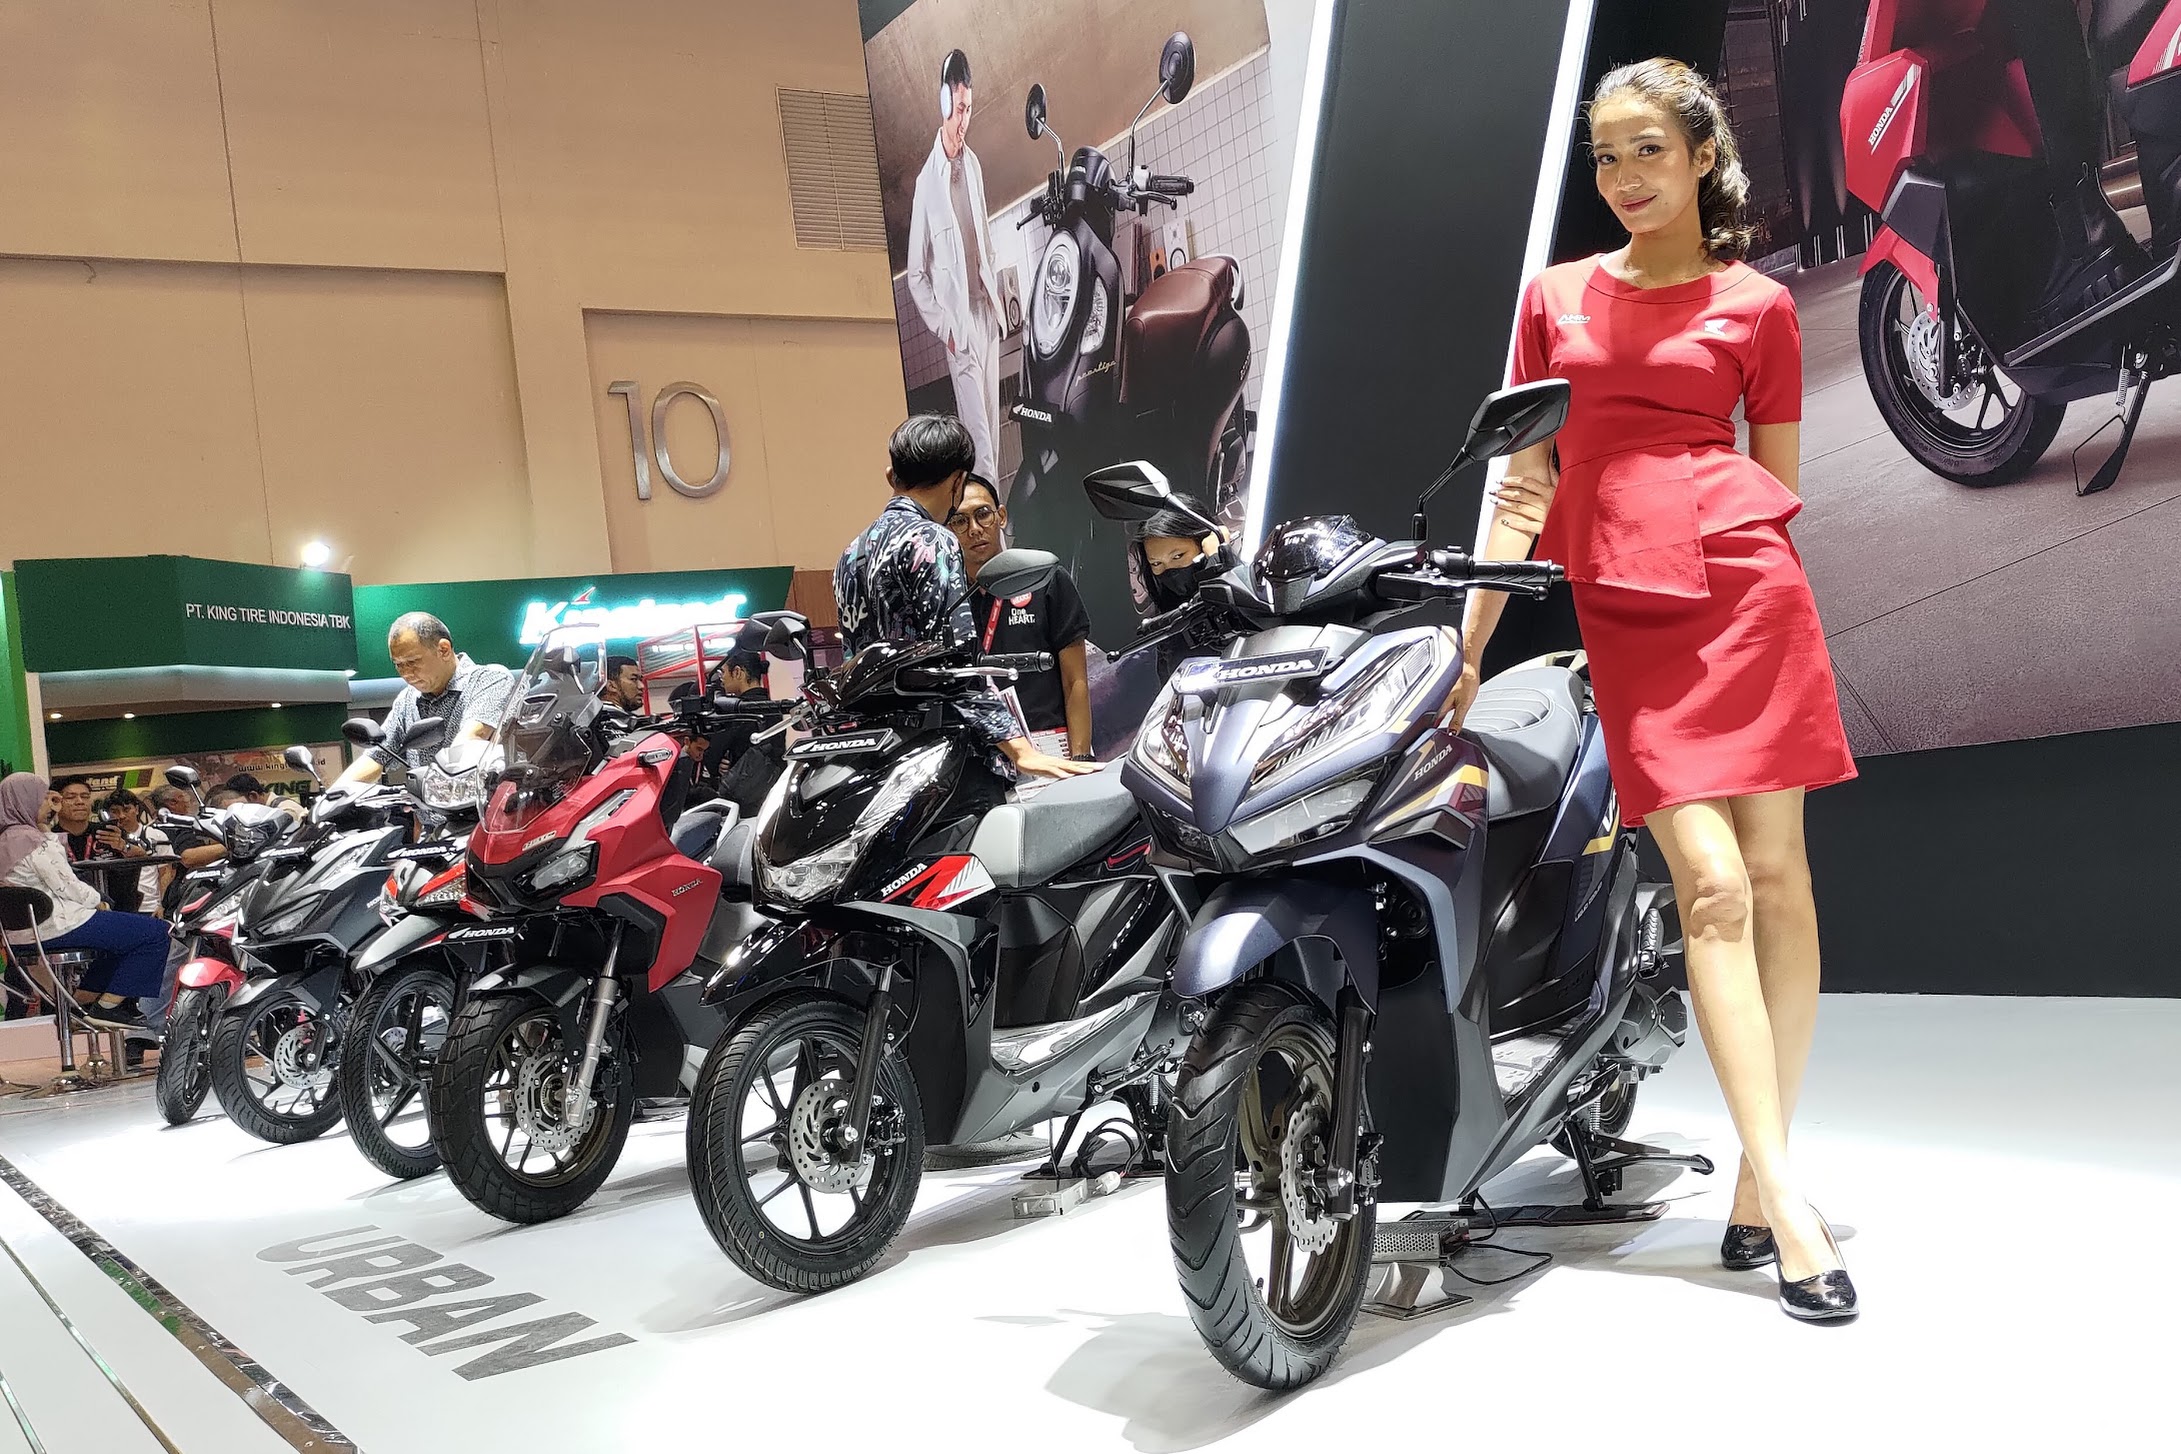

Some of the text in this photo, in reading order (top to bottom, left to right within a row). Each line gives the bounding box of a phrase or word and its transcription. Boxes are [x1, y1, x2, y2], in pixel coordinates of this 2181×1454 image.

[1868, 106, 1894, 146] HONDA
[1020, 406, 1052, 422] HONDA
[607, 380, 731, 500] 10
[186, 603, 351, 629] PT. KING TIRE INDONESIA TBK
[1217, 659, 1315, 681] HONDA
[809, 738, 876, 752] HONDA
[1413, 743, 1453, 782] HONDA
[401, 846, 447, 858] HONDA
[672, 878, 703, 897] HONDA
[880, 863, 928, 898] HONDA
[464, 926, 515, 939] HONDA
[255, 1224, 639, 1382] URBAN
